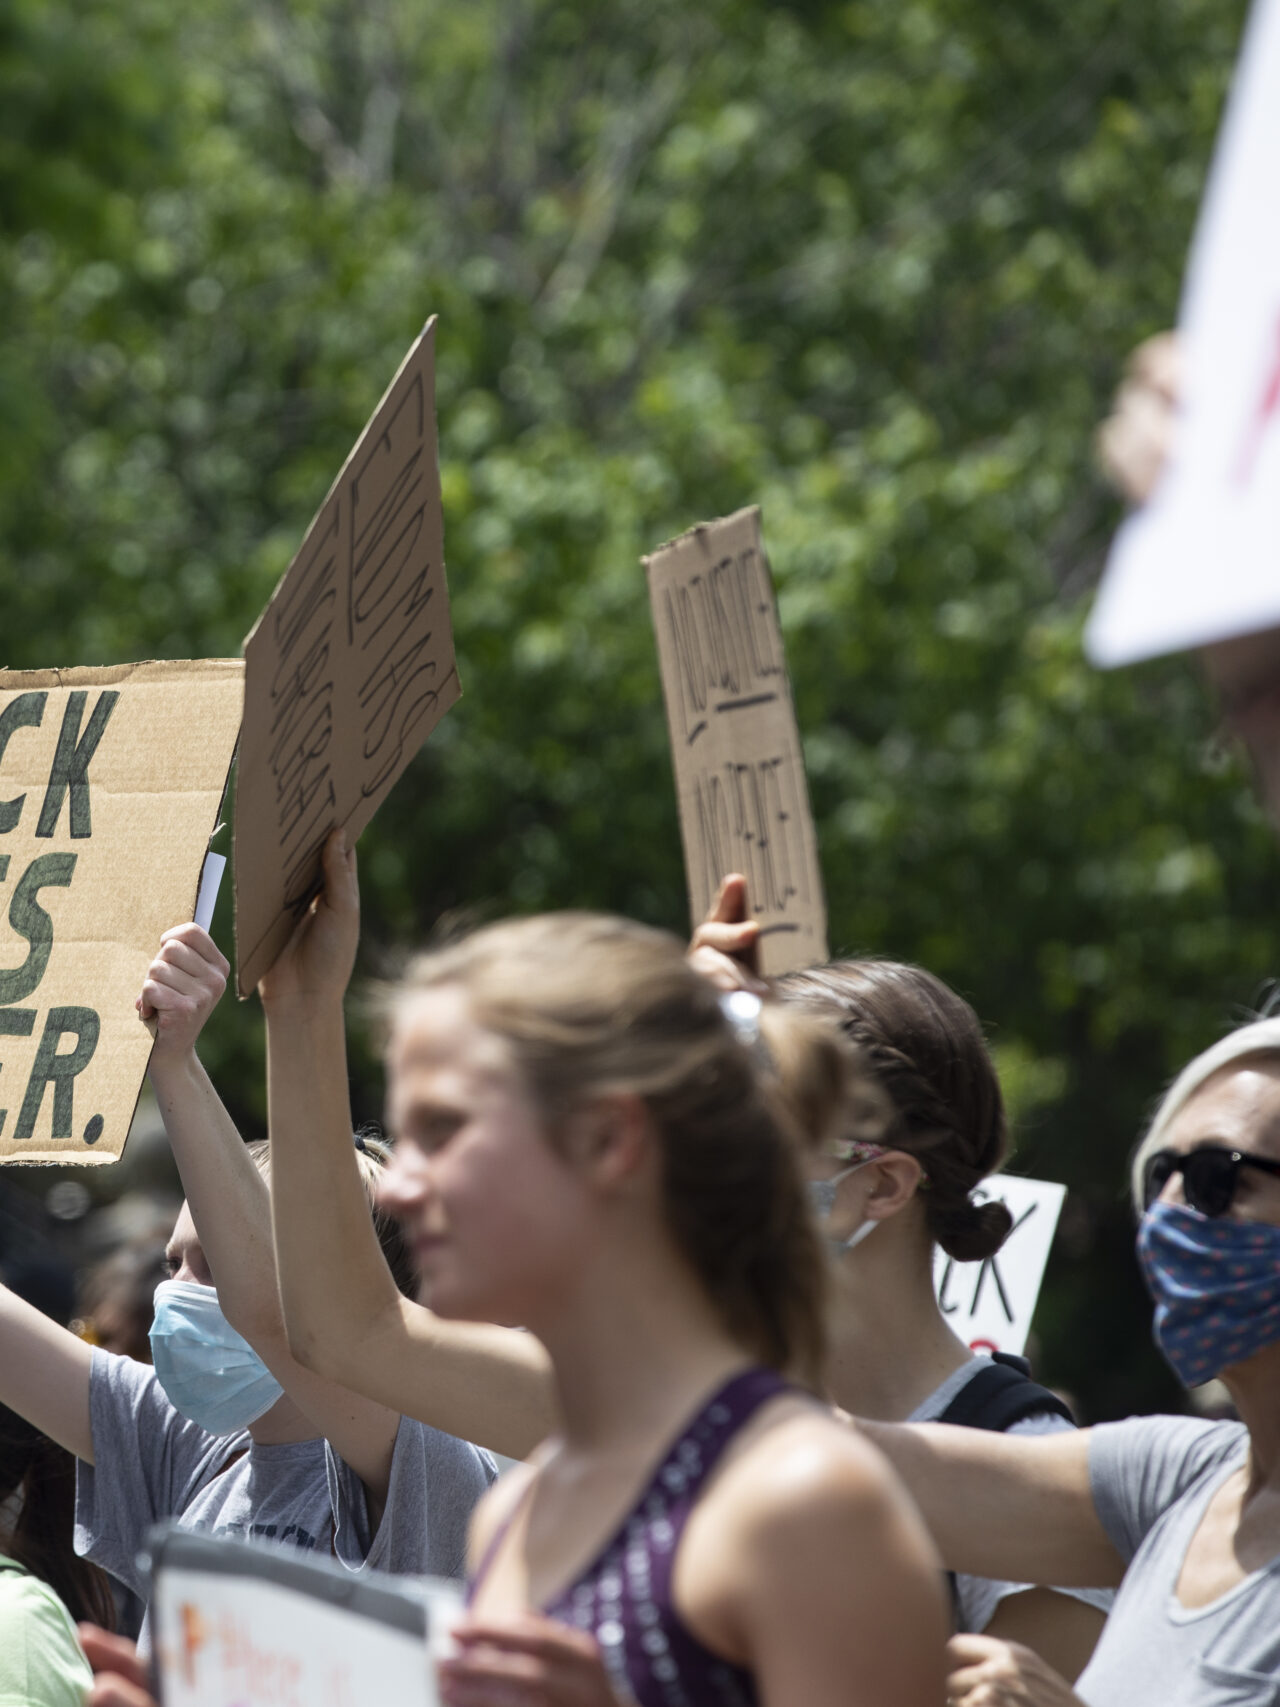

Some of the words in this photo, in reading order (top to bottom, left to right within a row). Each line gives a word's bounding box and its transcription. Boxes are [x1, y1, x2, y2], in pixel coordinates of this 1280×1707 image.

[351, 372, 428, 623] END
[269, 501, 338, 917] INCARCERATIO
[357, 562, 439, 798] MASS
